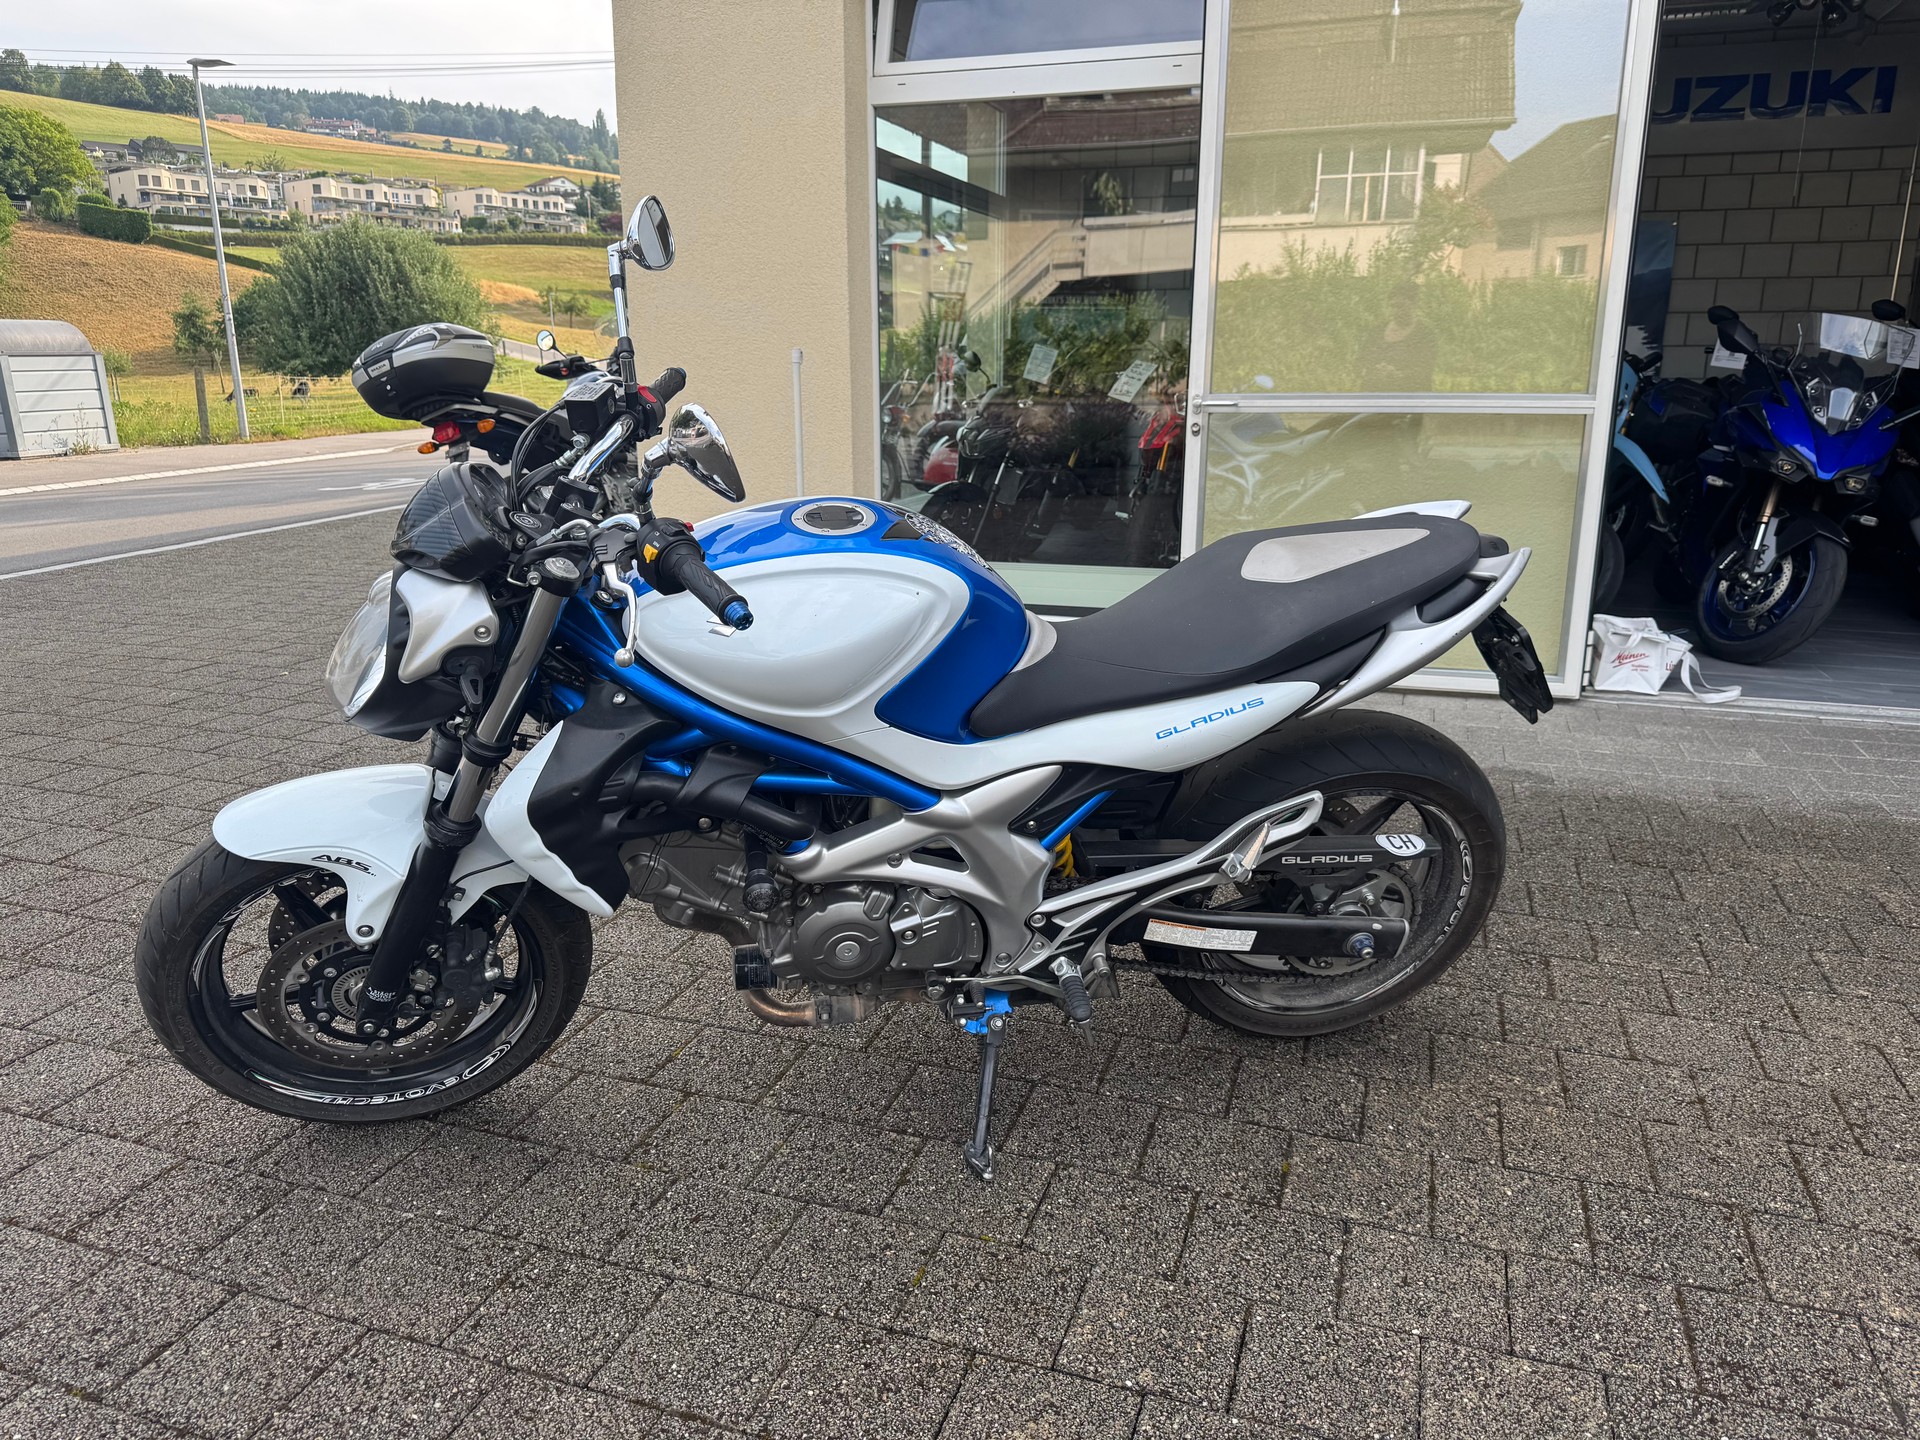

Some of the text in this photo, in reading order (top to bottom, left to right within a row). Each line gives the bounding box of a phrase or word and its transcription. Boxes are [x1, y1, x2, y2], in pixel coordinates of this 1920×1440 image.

[1155, 697, 1265, 740] GLADIUS
[1386, 834, 1417, 850] CH
[311, 854, 372, 874] ABS
[1281, 854, 1373, 864] GLADIUS
[322, 1076, 460, 1105] EVOTECH
